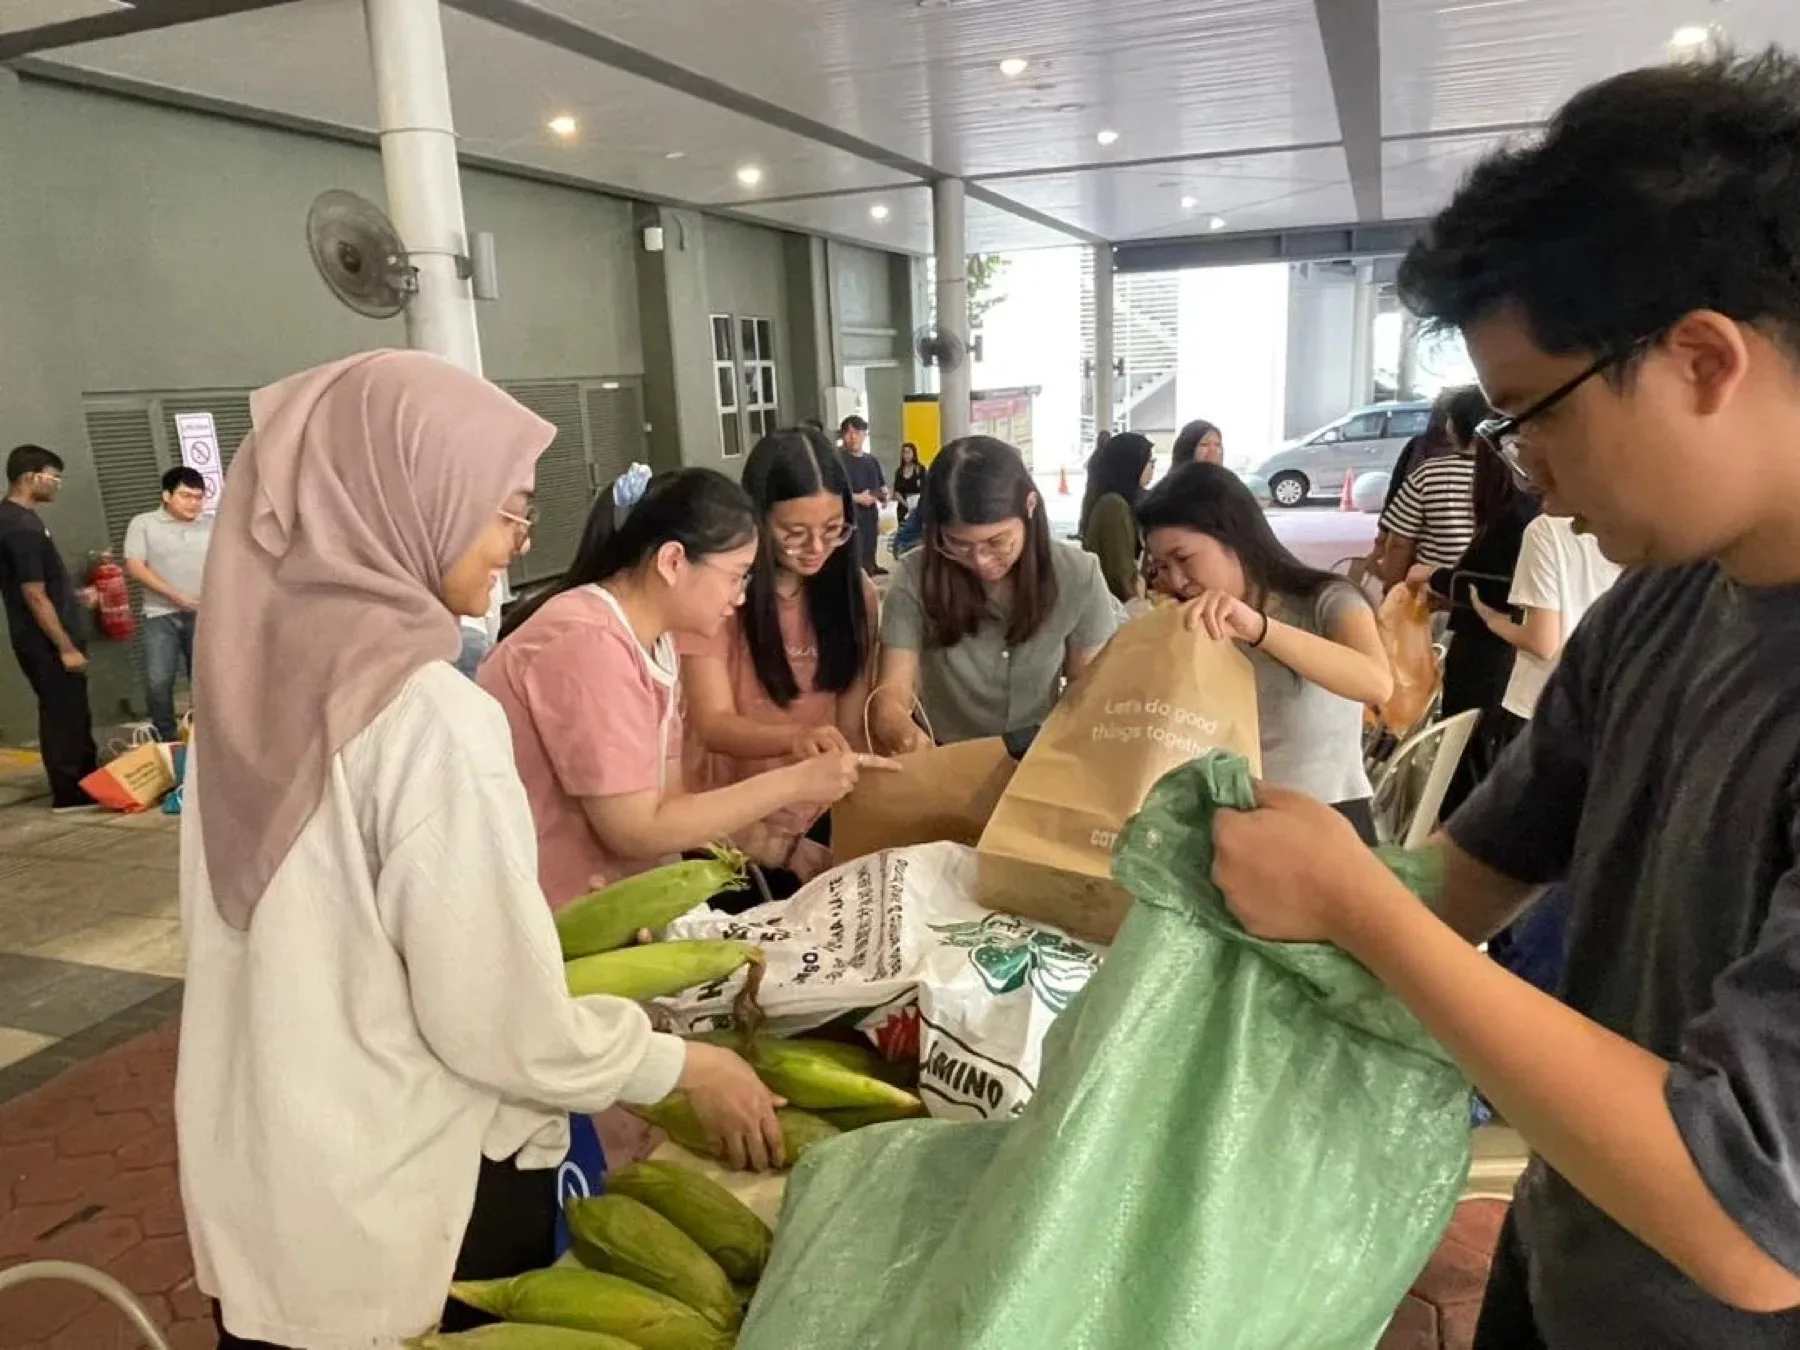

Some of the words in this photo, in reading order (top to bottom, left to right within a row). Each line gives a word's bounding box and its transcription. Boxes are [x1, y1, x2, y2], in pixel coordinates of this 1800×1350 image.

[1145, 698, 1170, 716] do
[1175, 708, 1217, 735] good
[1092, 722, 1141, 743] things
[1090, 830, 1119, 849] COT
